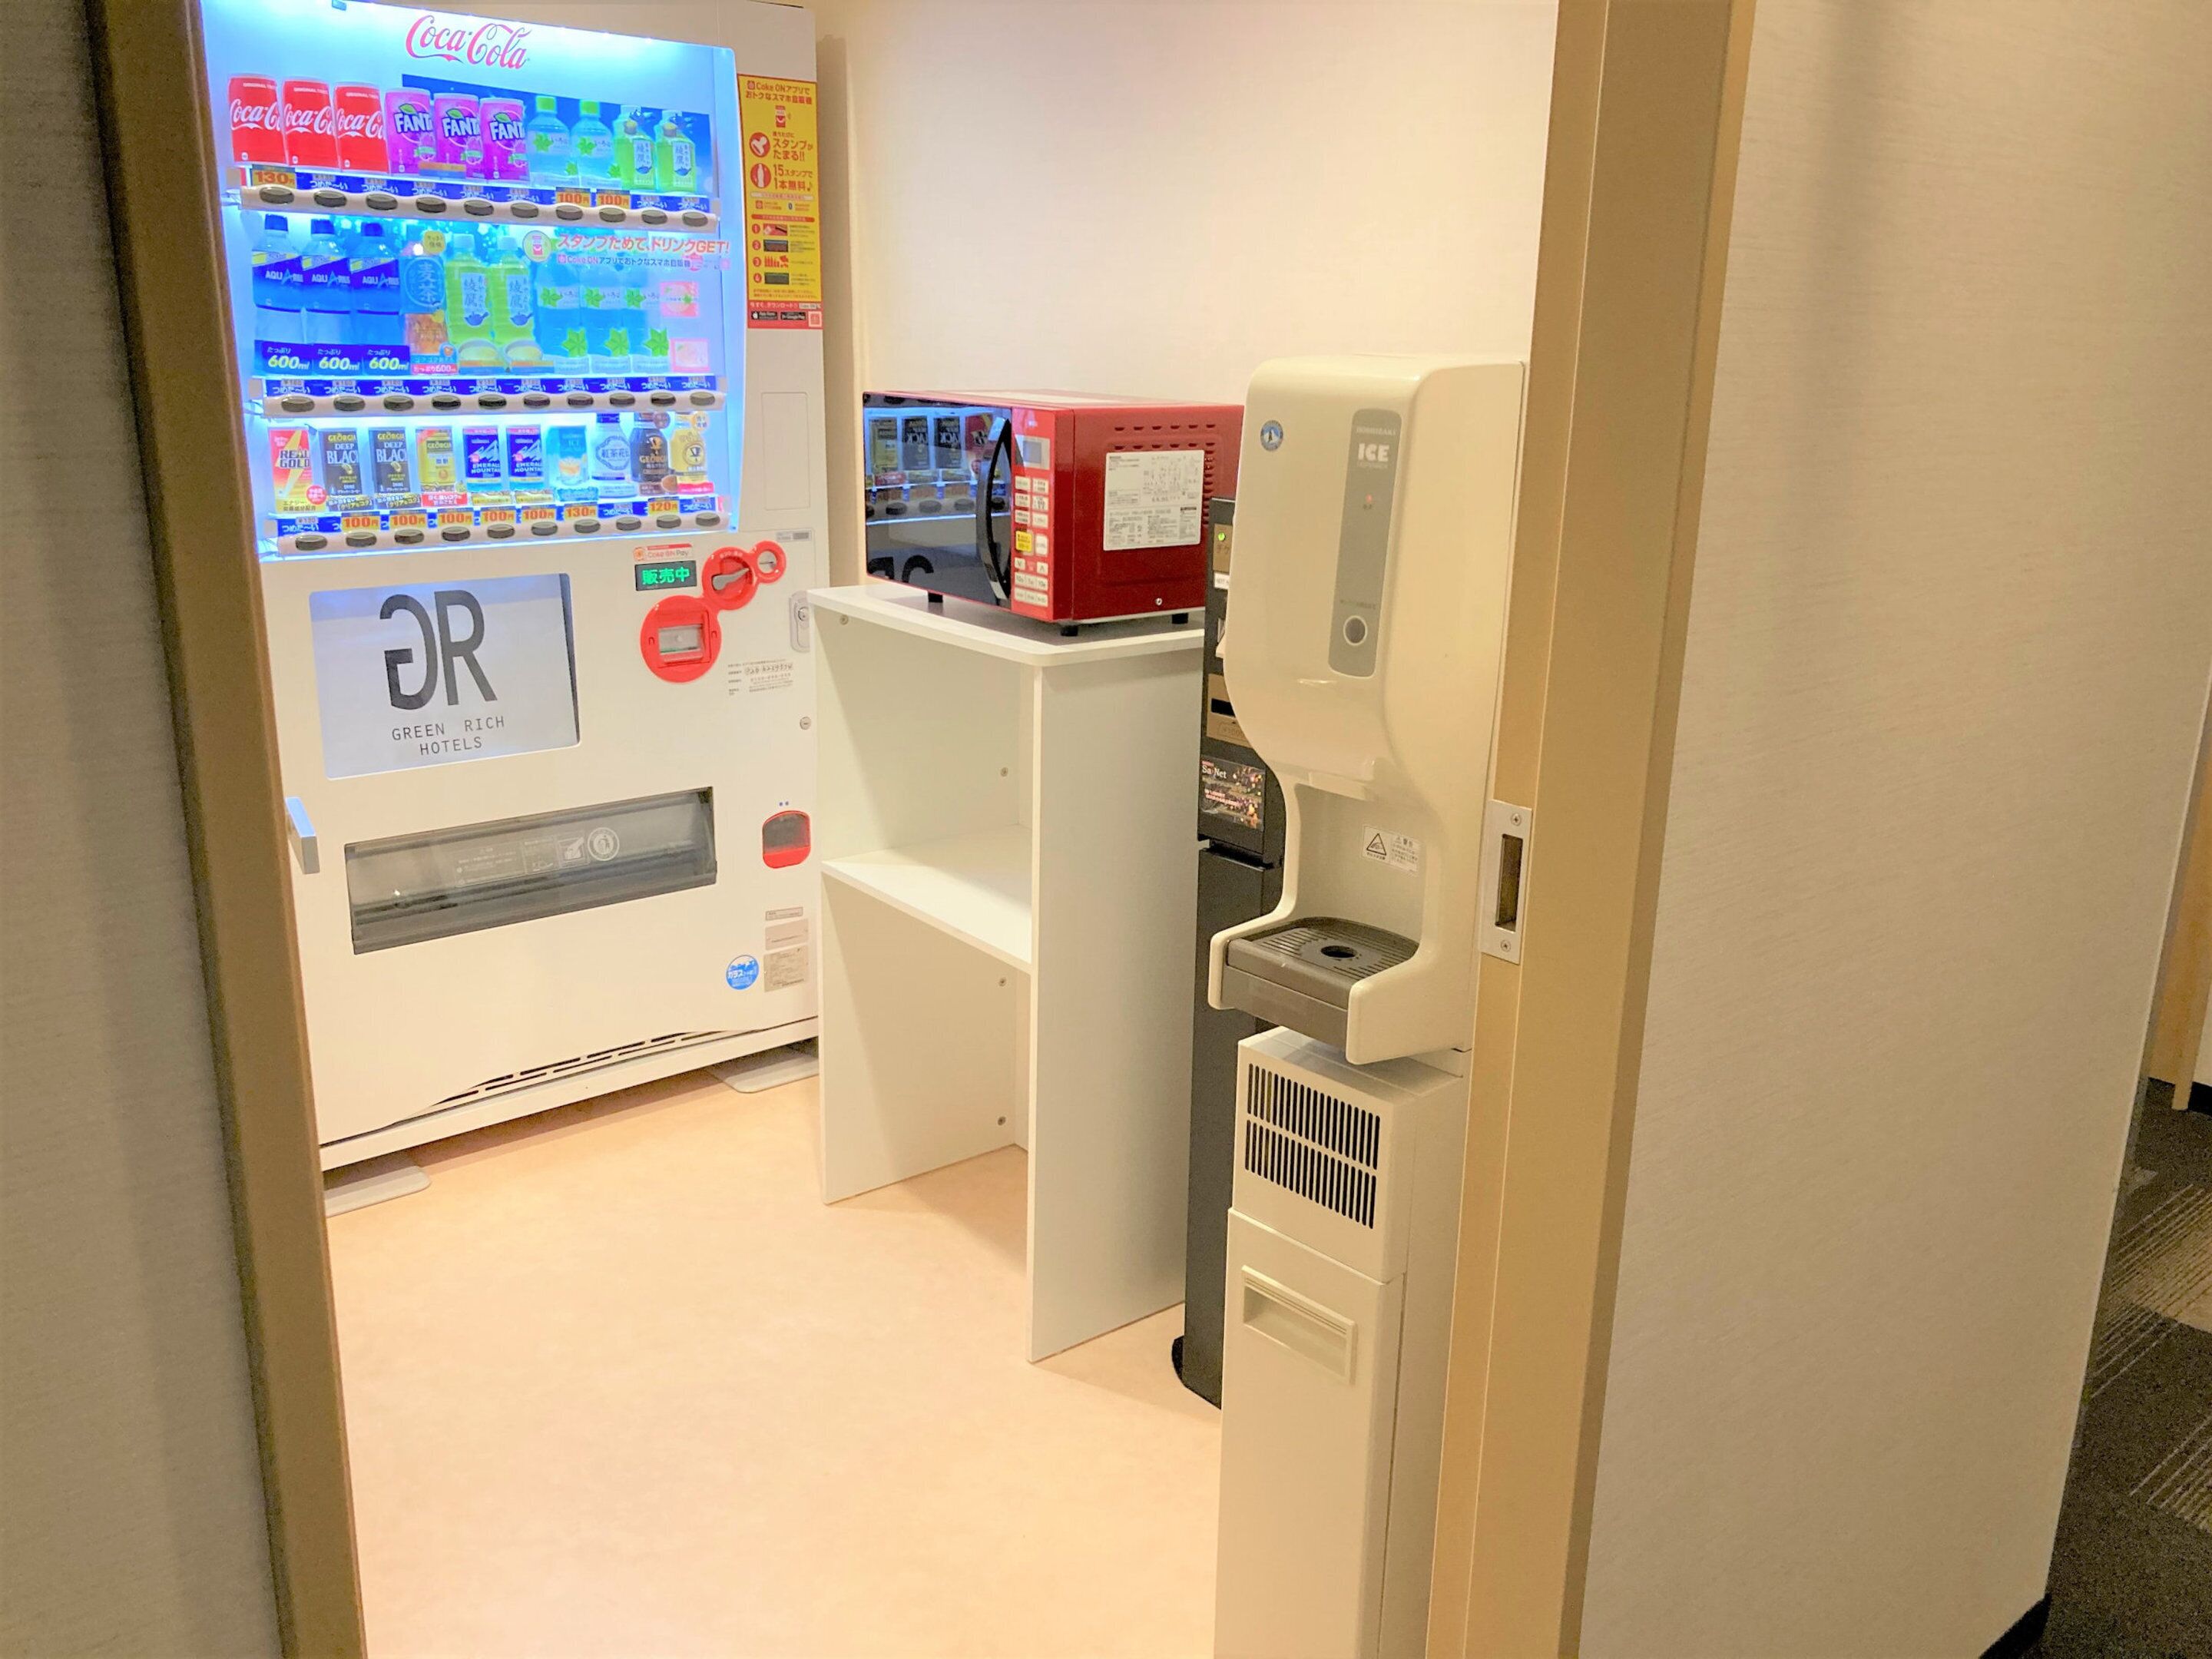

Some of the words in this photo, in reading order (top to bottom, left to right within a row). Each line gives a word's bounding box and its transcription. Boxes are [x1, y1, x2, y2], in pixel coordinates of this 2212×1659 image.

[406, 15, 531, 70] Coca-Cola
[394, 112, 433, 134] FANT
[442, 117, 480, 137] FANT
[489, 121, 525, 141] FANT
[268, 356, 310, 370] 600ml
[319, 356, 359, 371] 600ml
[369, 357, 409, 371] 600ml
[326, 450, 358, 464] BLAC
[376, 449, 406, 462] BLAC
[1358, 443, 1389, 462] ICE
[641, 566, 690, 585] 販売中
[392, 723, 445, 741] GREEN
[465, 717, 505, 733] RICH
[419, 737, 483, 756] HOTELS
